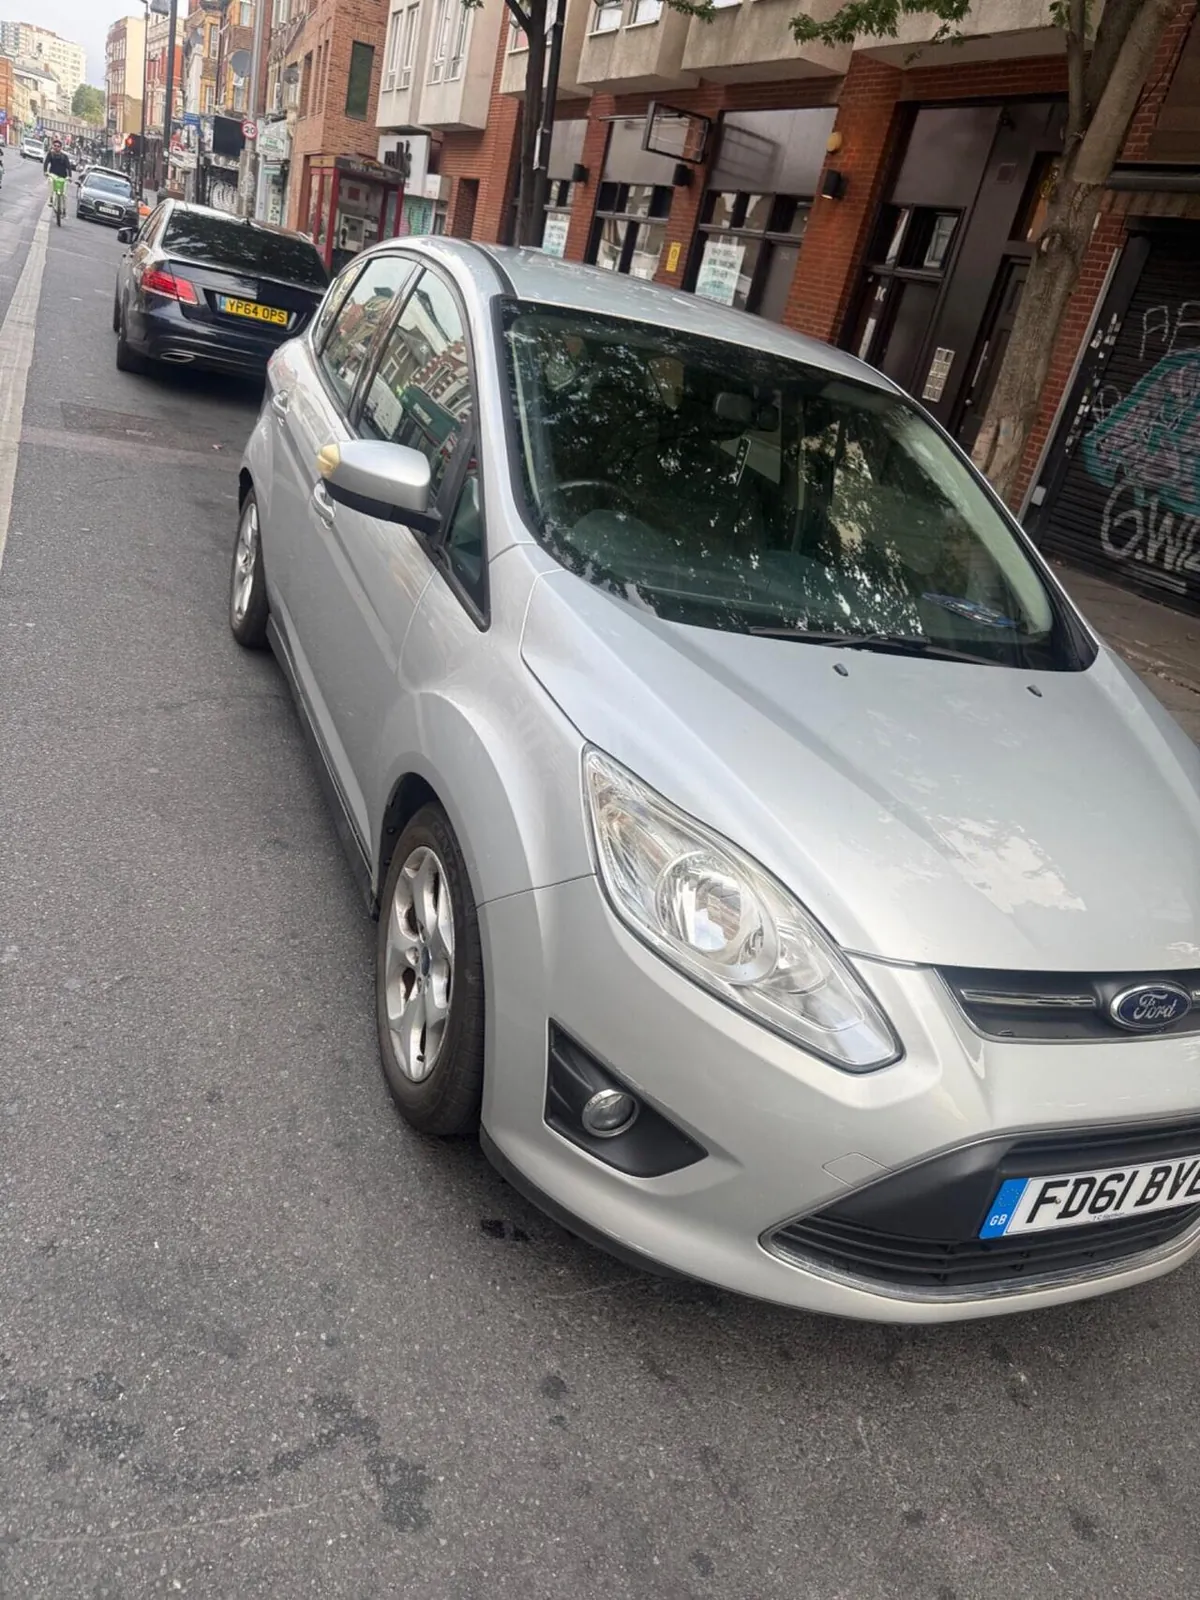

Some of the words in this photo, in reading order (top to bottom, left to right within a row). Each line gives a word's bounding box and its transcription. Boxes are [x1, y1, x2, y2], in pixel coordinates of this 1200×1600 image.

[228, 299, 259, 317] YP64
[1133, 993, 1178, 1020] Ford
[1026, 1169, 1140, 1224] FD61
[989, 1213, 1009, 1227] GB
